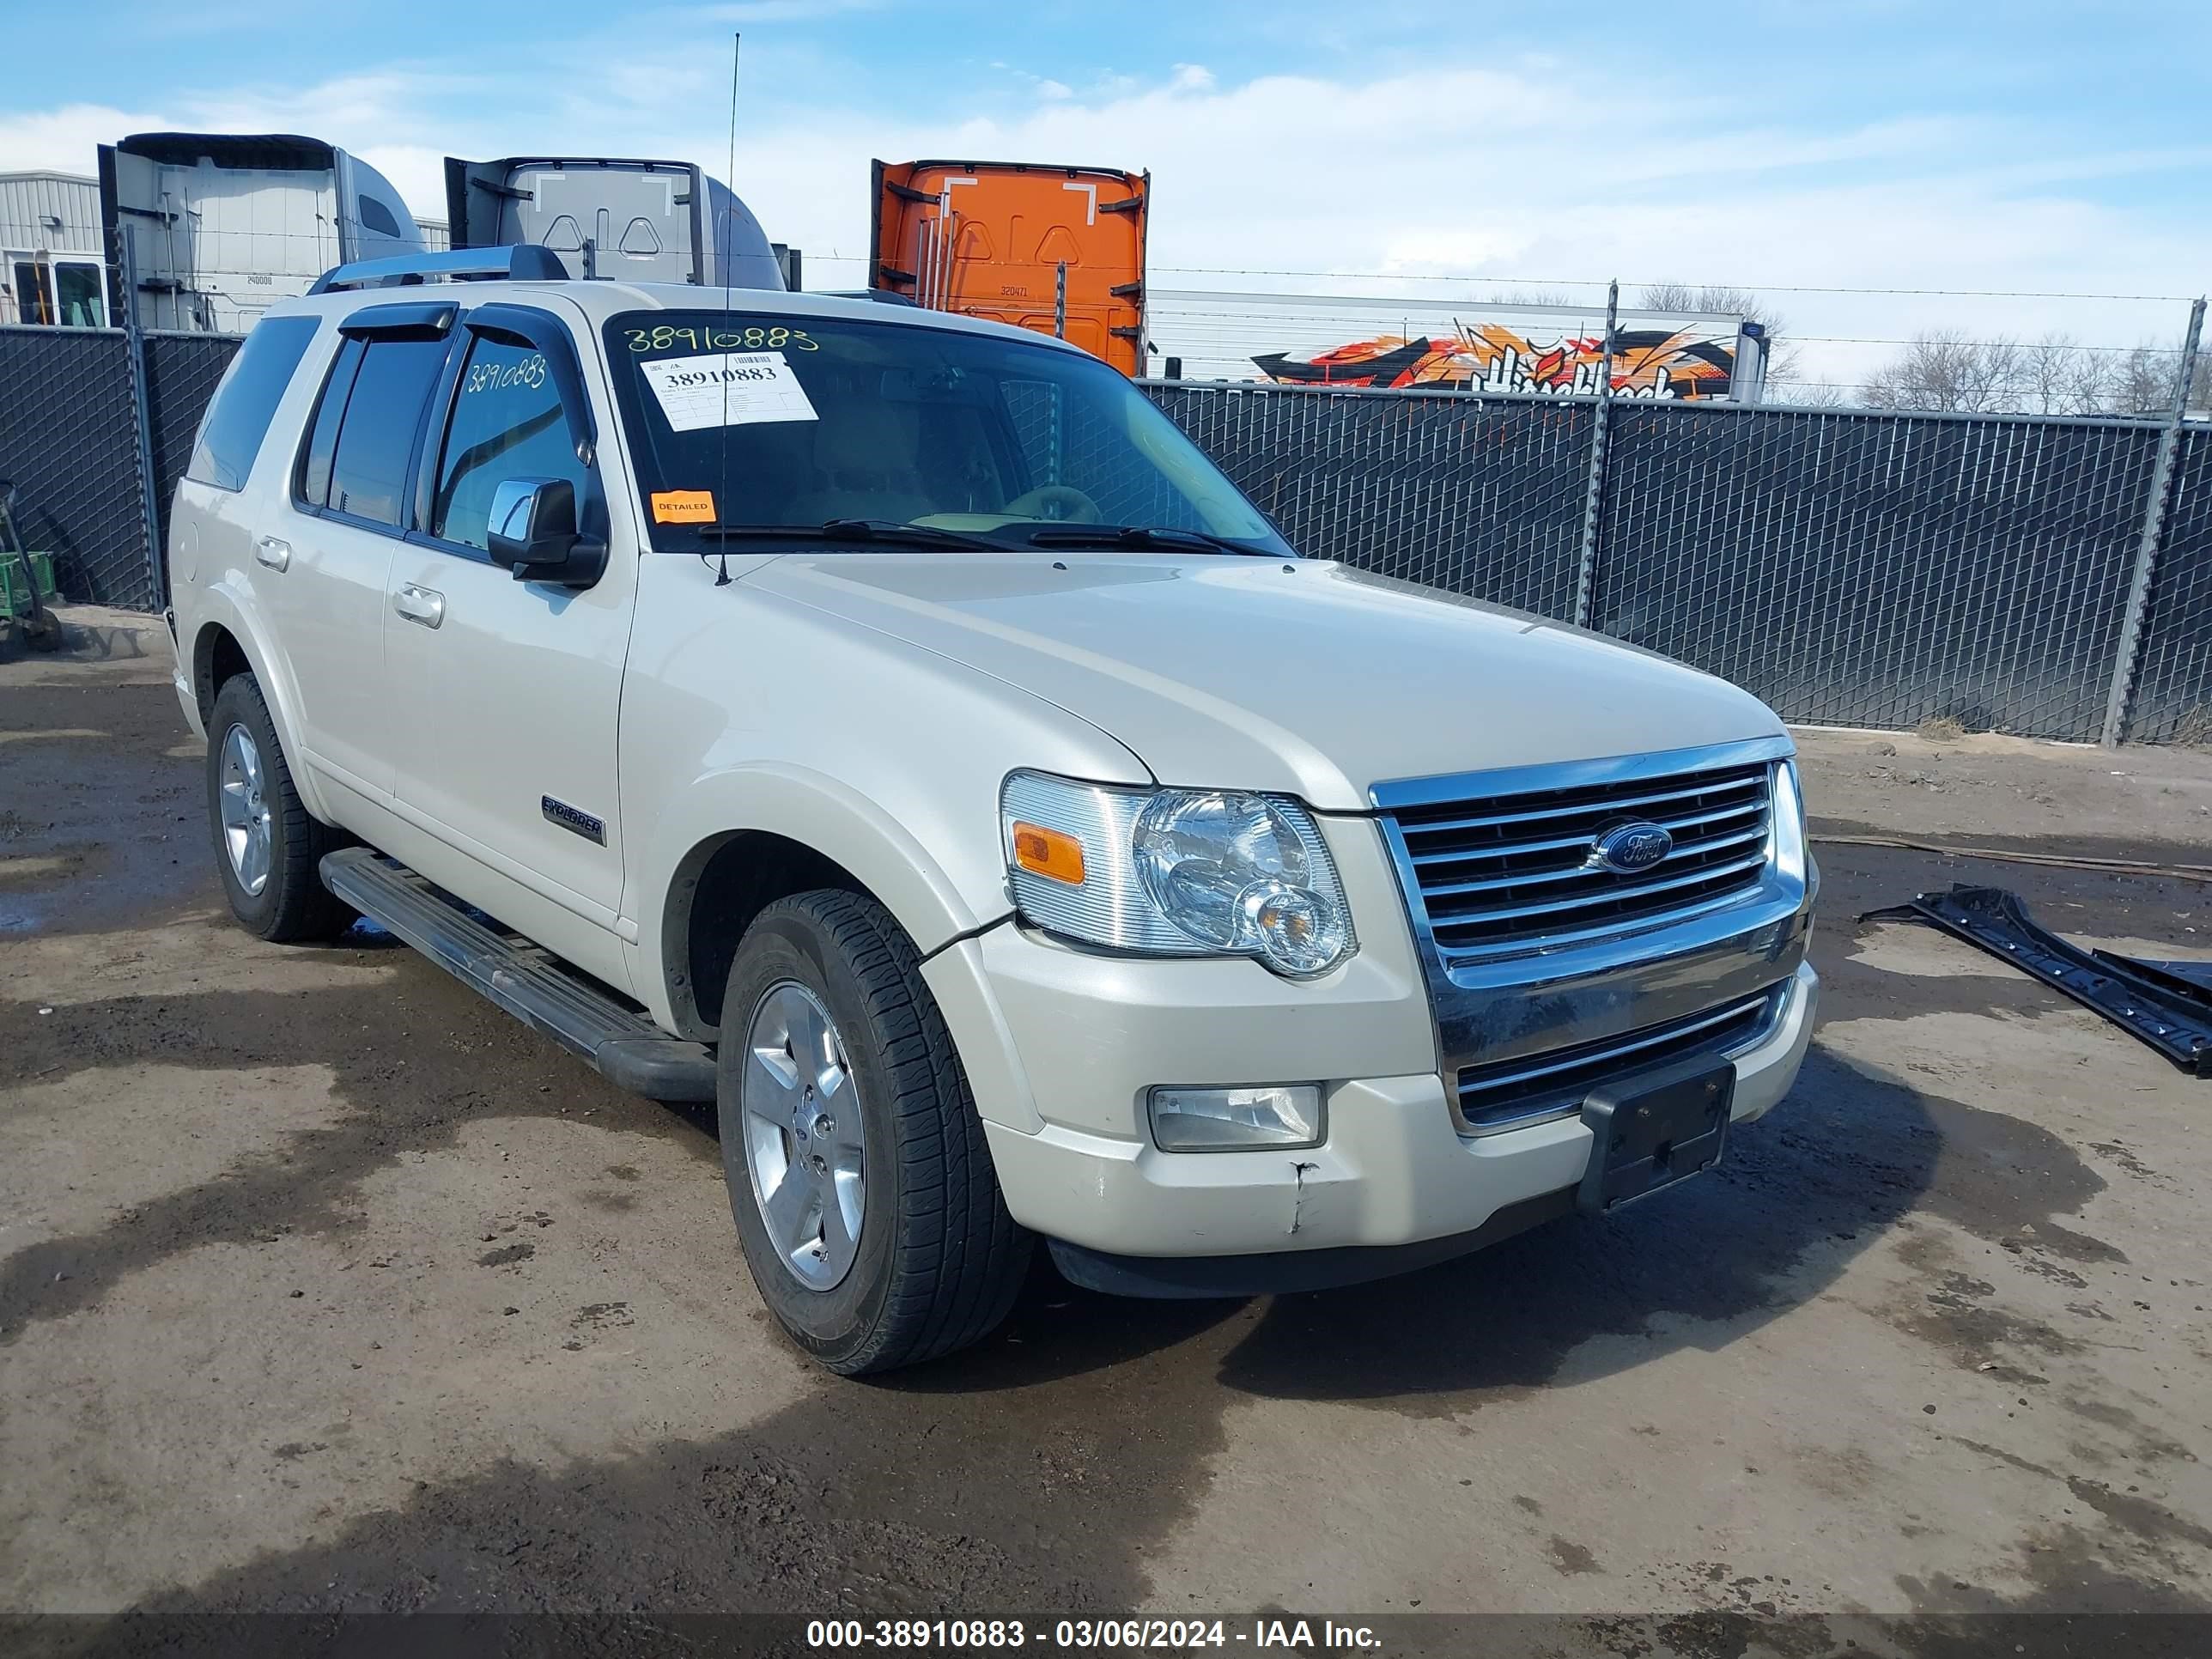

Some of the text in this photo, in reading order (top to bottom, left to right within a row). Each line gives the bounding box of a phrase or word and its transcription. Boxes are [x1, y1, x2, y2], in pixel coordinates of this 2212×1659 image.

[1001, 286, 1028, 296] 320471
[623, 325, 820, 352] 38910883
[468, 354, 546, 393] 38910883
[665, 367, 777, 388] 38910883
[659, 502, 708, 511] DETAILED
[543, 798, 602, 834] EXPLORER
[1624, 833, 1662, 863] Ford
